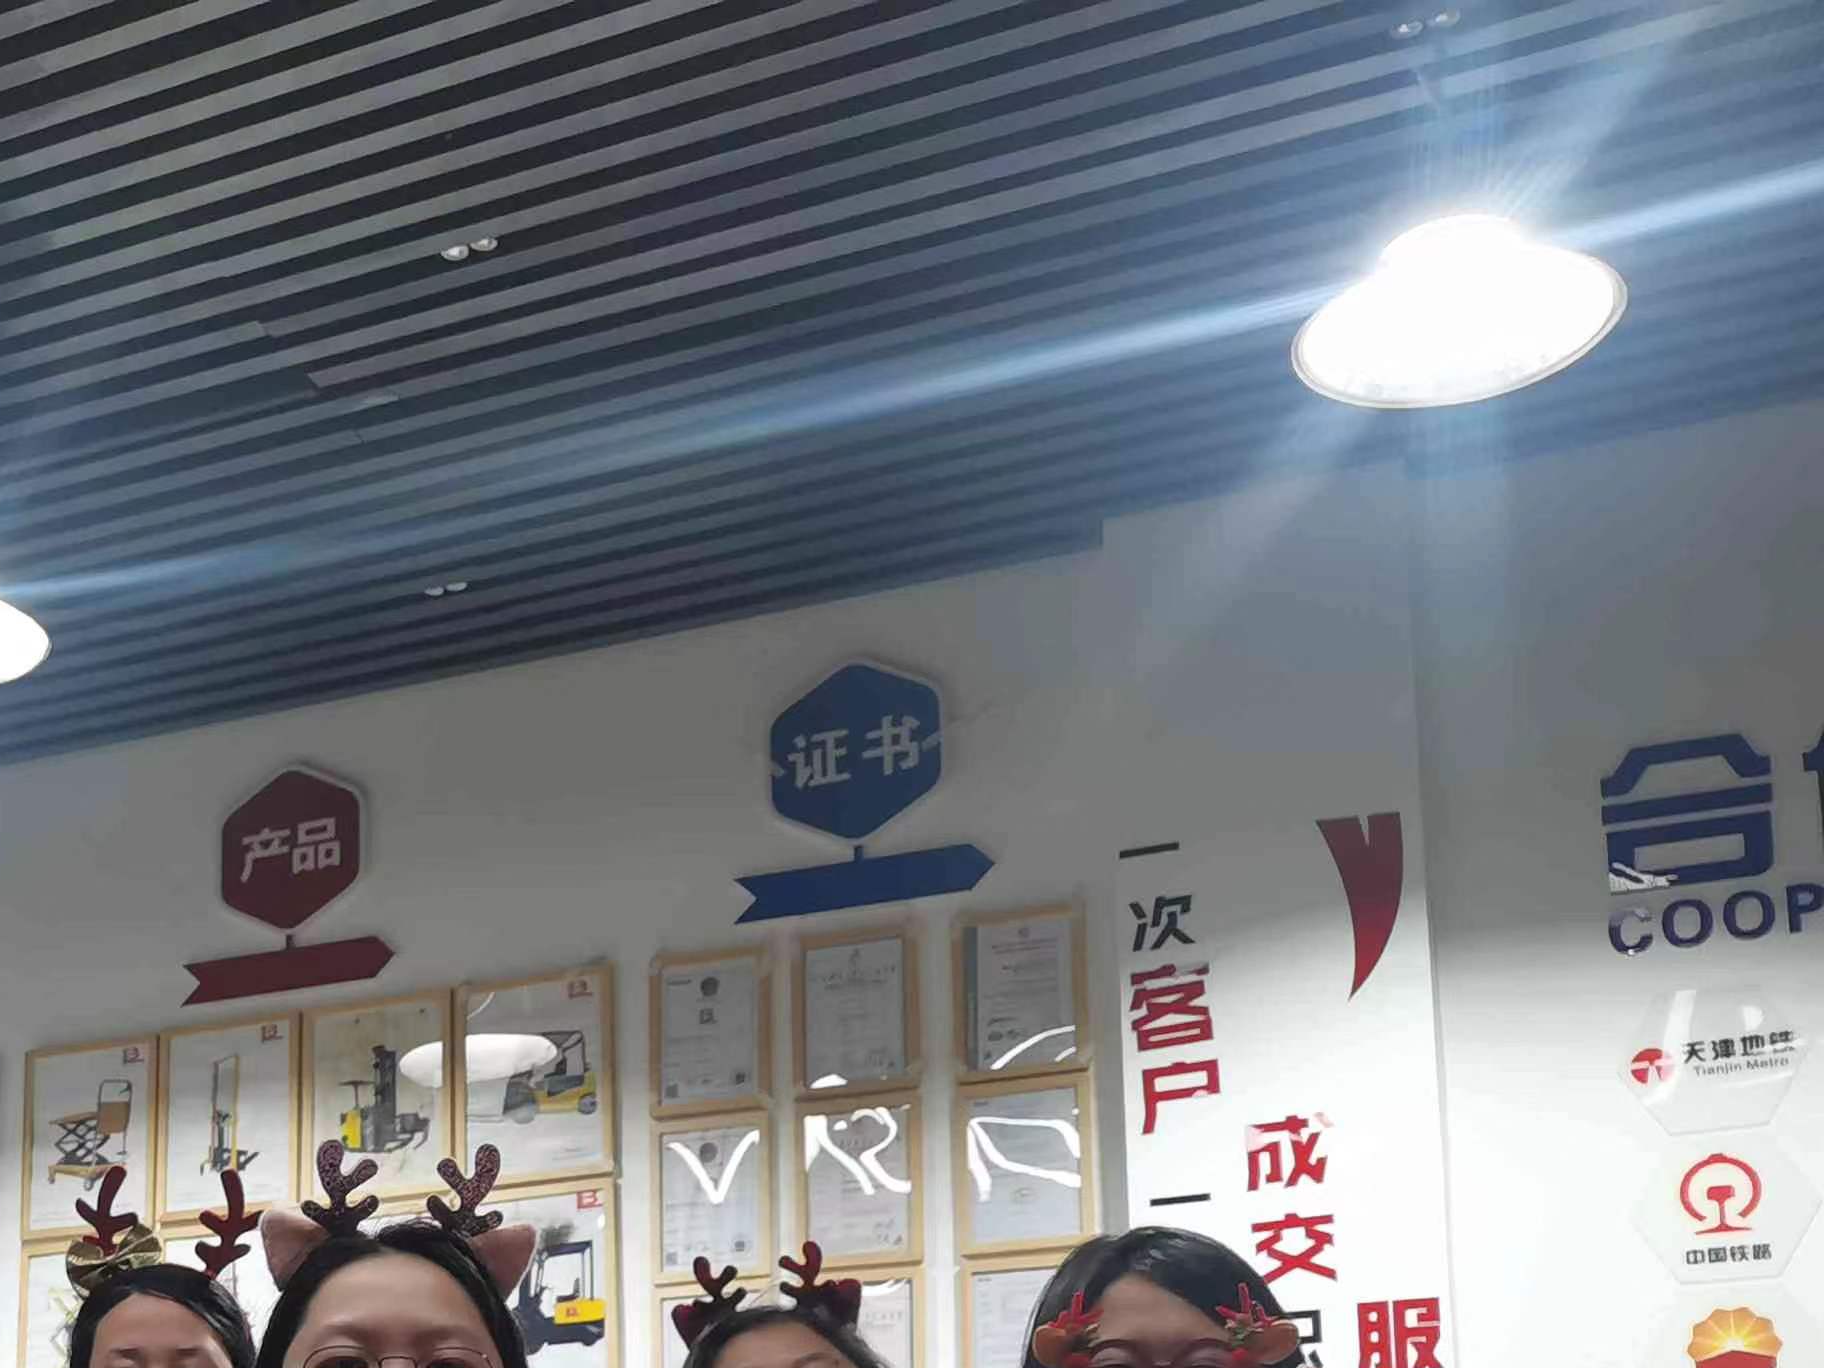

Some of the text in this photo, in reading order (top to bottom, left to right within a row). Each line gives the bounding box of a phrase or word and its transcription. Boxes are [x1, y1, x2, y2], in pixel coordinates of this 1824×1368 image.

[787, 714, 921, 789] 证书
[240, 816, 342, 883] 产品
[1686, 1243, 1773, 1265] 中国铁路
